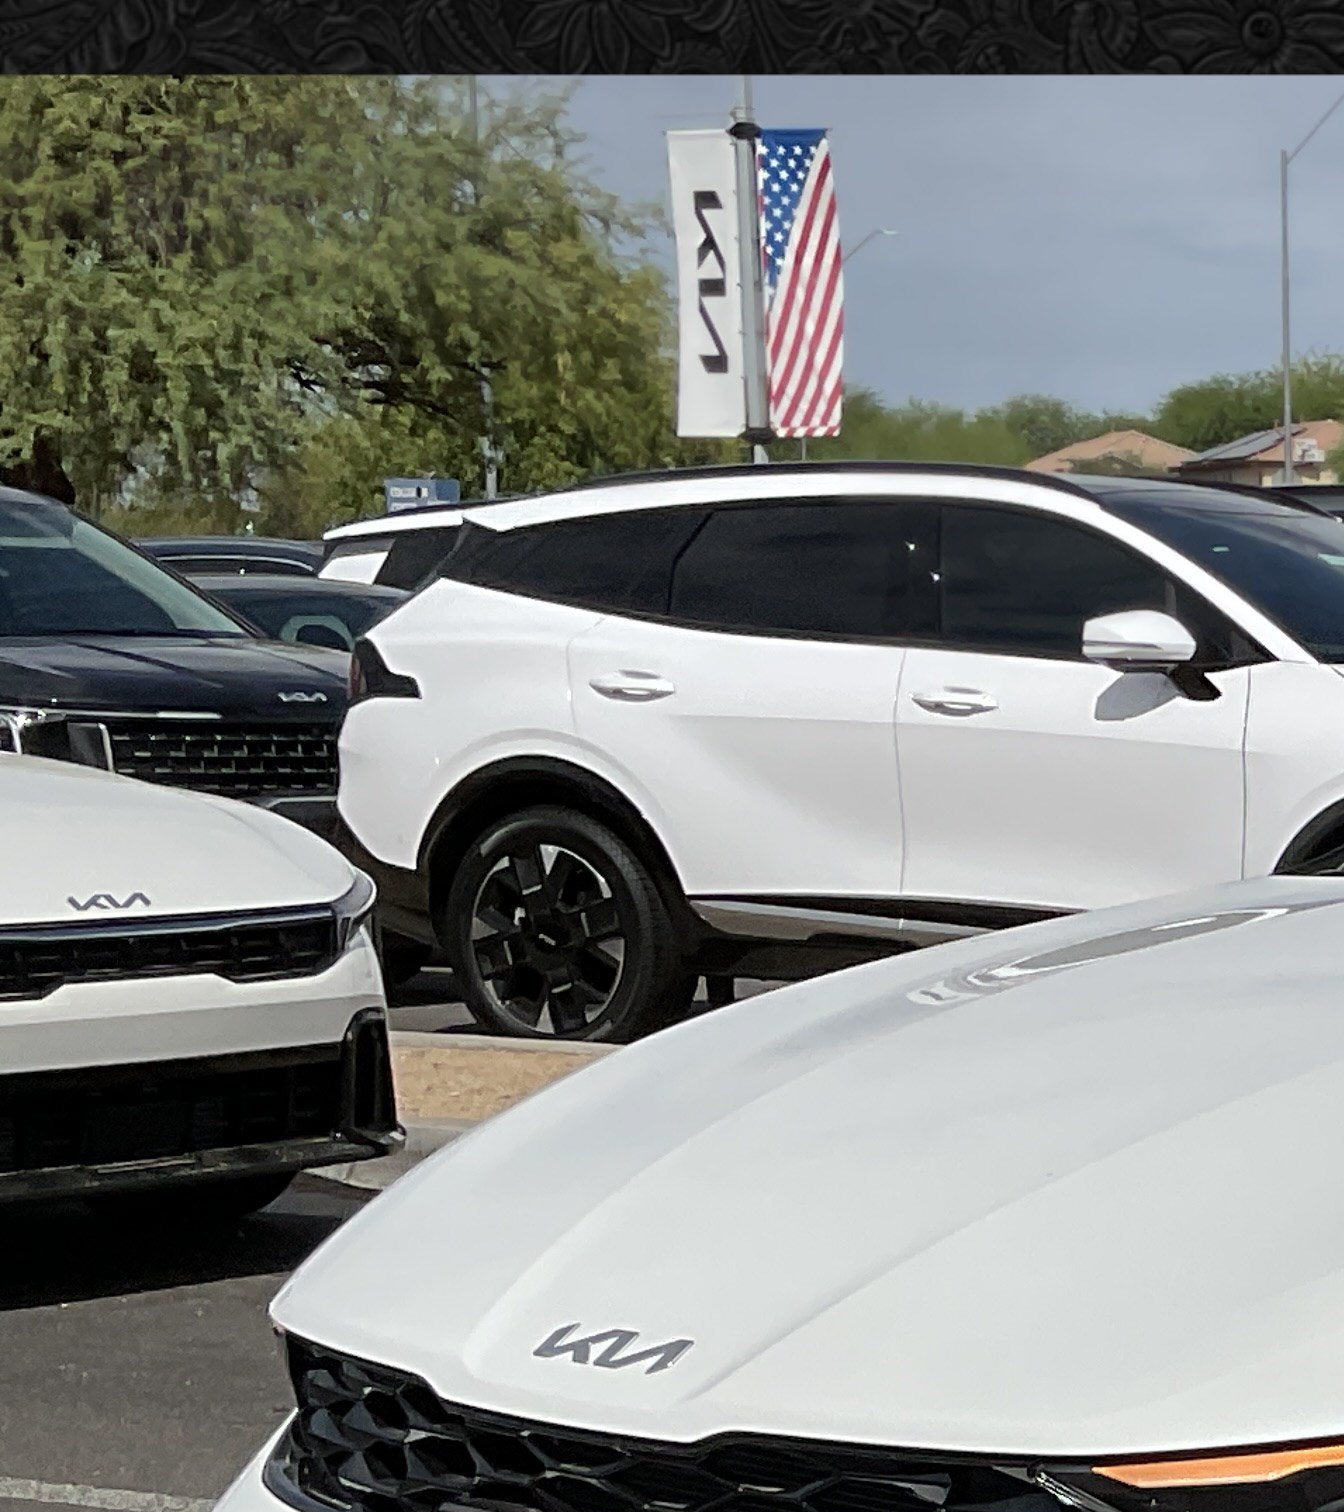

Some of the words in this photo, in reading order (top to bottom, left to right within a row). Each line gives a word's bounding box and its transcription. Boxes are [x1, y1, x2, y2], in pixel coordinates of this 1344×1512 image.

[693, 190, 729, 374] KIA
[67, 892, 152, 911] KIA
[533, 1322, 695, 1375] KIA
